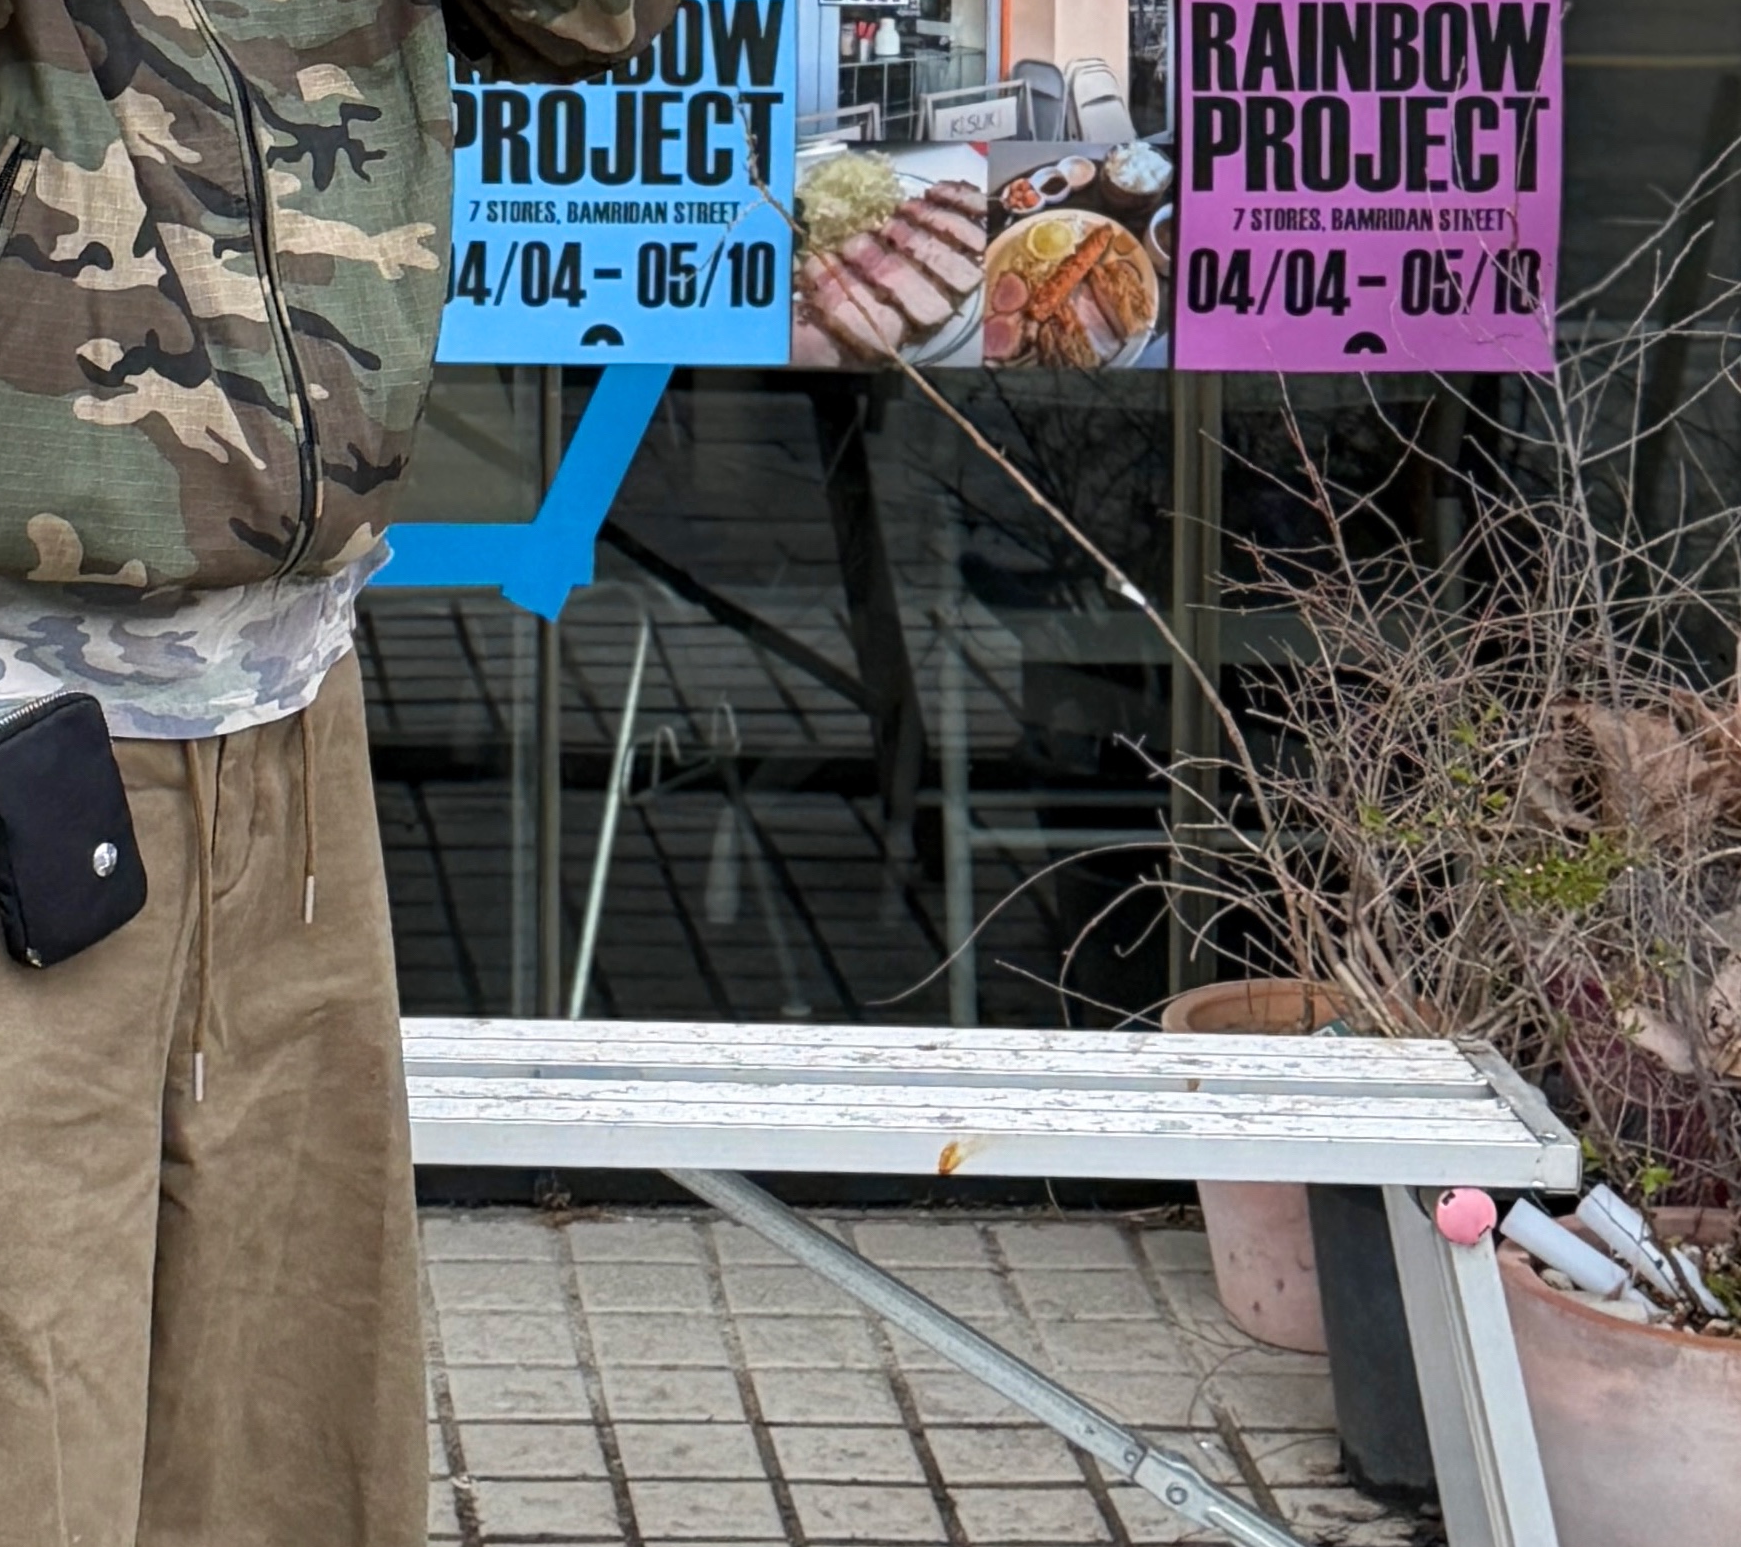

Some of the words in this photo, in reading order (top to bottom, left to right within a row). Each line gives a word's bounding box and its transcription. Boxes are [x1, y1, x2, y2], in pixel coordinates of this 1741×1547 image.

[1191, 1, 1551, 93] RAINBOW
[1191, 96, 1551, 194] PROJECT
[468, 201, 480, 222] 7
[486, 201, 561, 225] STORES,
[566, 202, 668, 224] BAMRIDAN
[673, 201, 741, 225] STREET
[1232, 208, 1244, 232] 7
[1250, 208, 1326, 234] STORES,
[1331, 209, 1433, 232] BAMRIDAN
[636, 240, 776, 309] 05/10
[1401, 248, 1541, 316] 05/10
